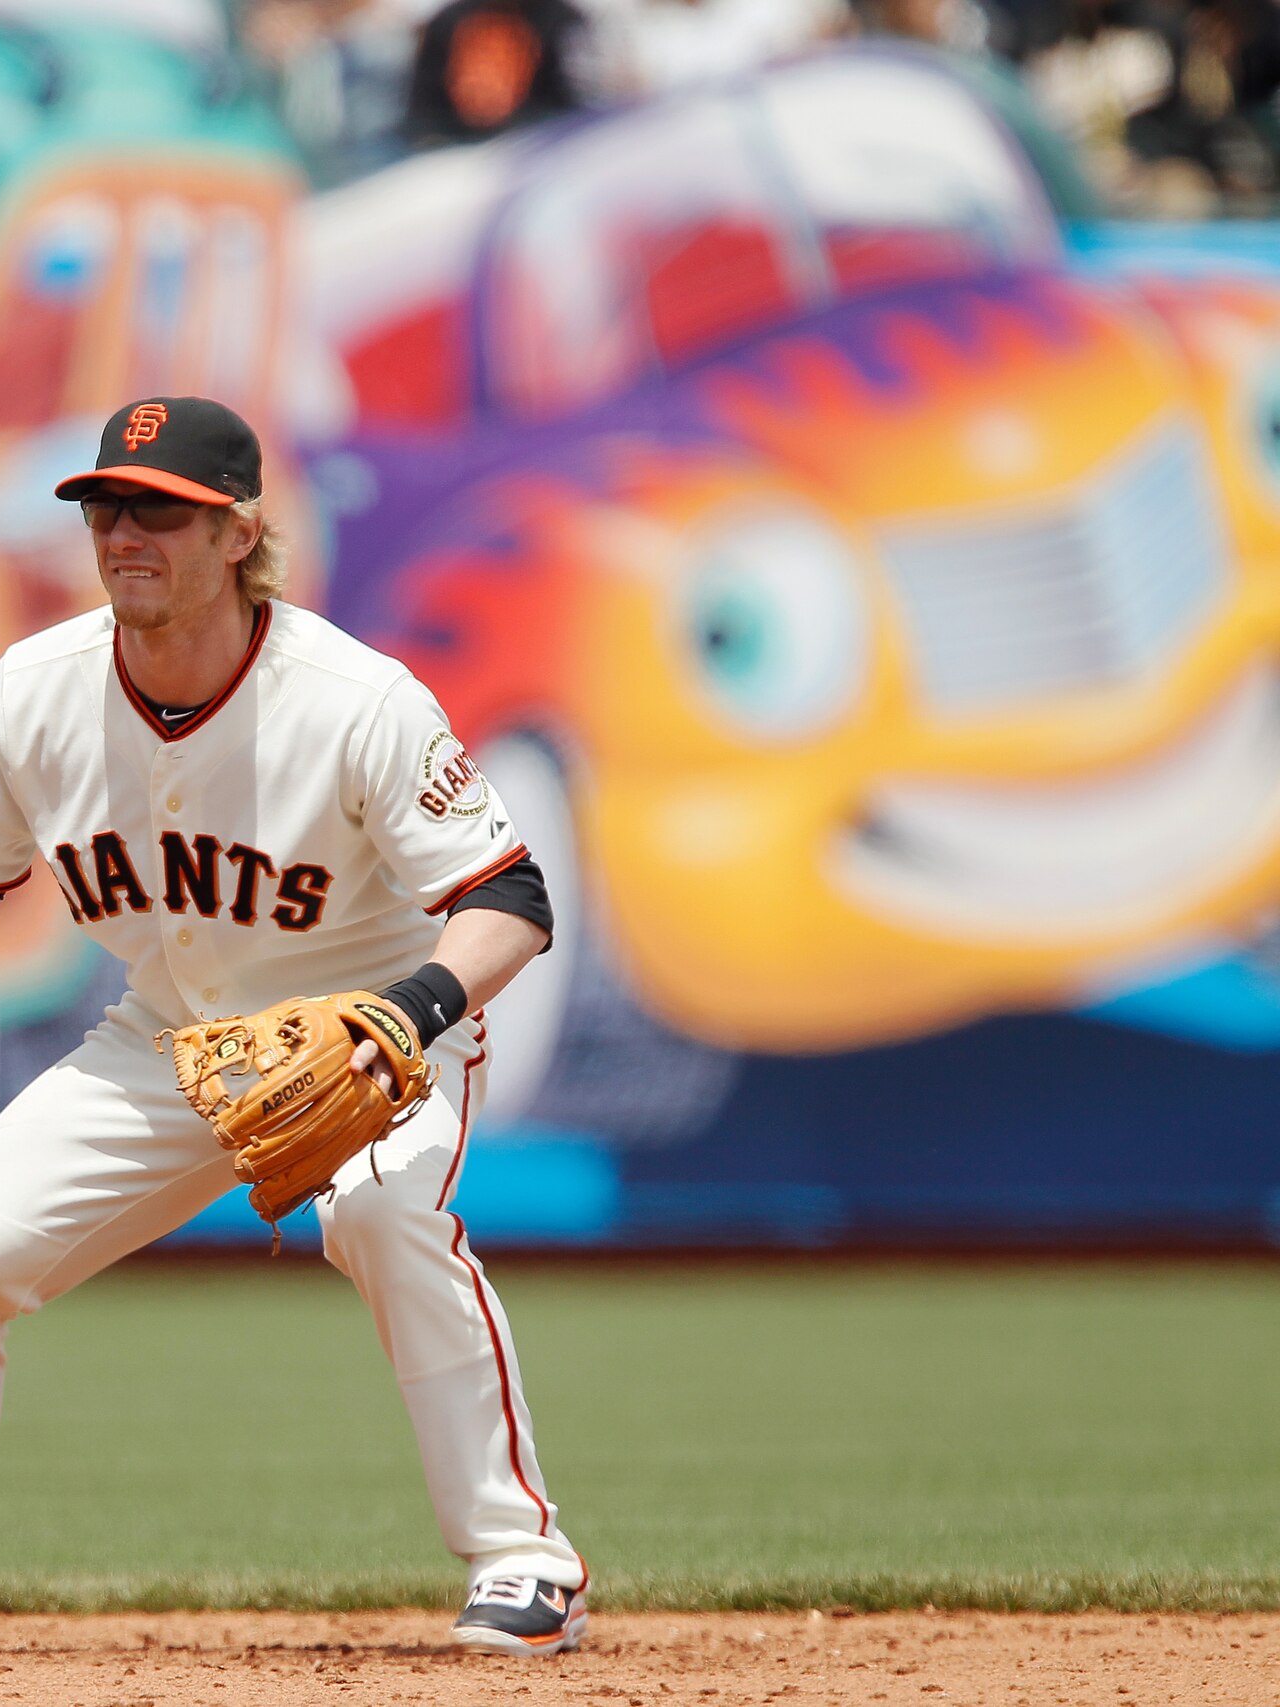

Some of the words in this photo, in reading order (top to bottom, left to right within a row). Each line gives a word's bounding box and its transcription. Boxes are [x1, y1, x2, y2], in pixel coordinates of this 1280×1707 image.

[123, 402, 168, 452] SF
[56, 829, 335, 933] IANTS
[262, 1071, 315, 1116] A2000
